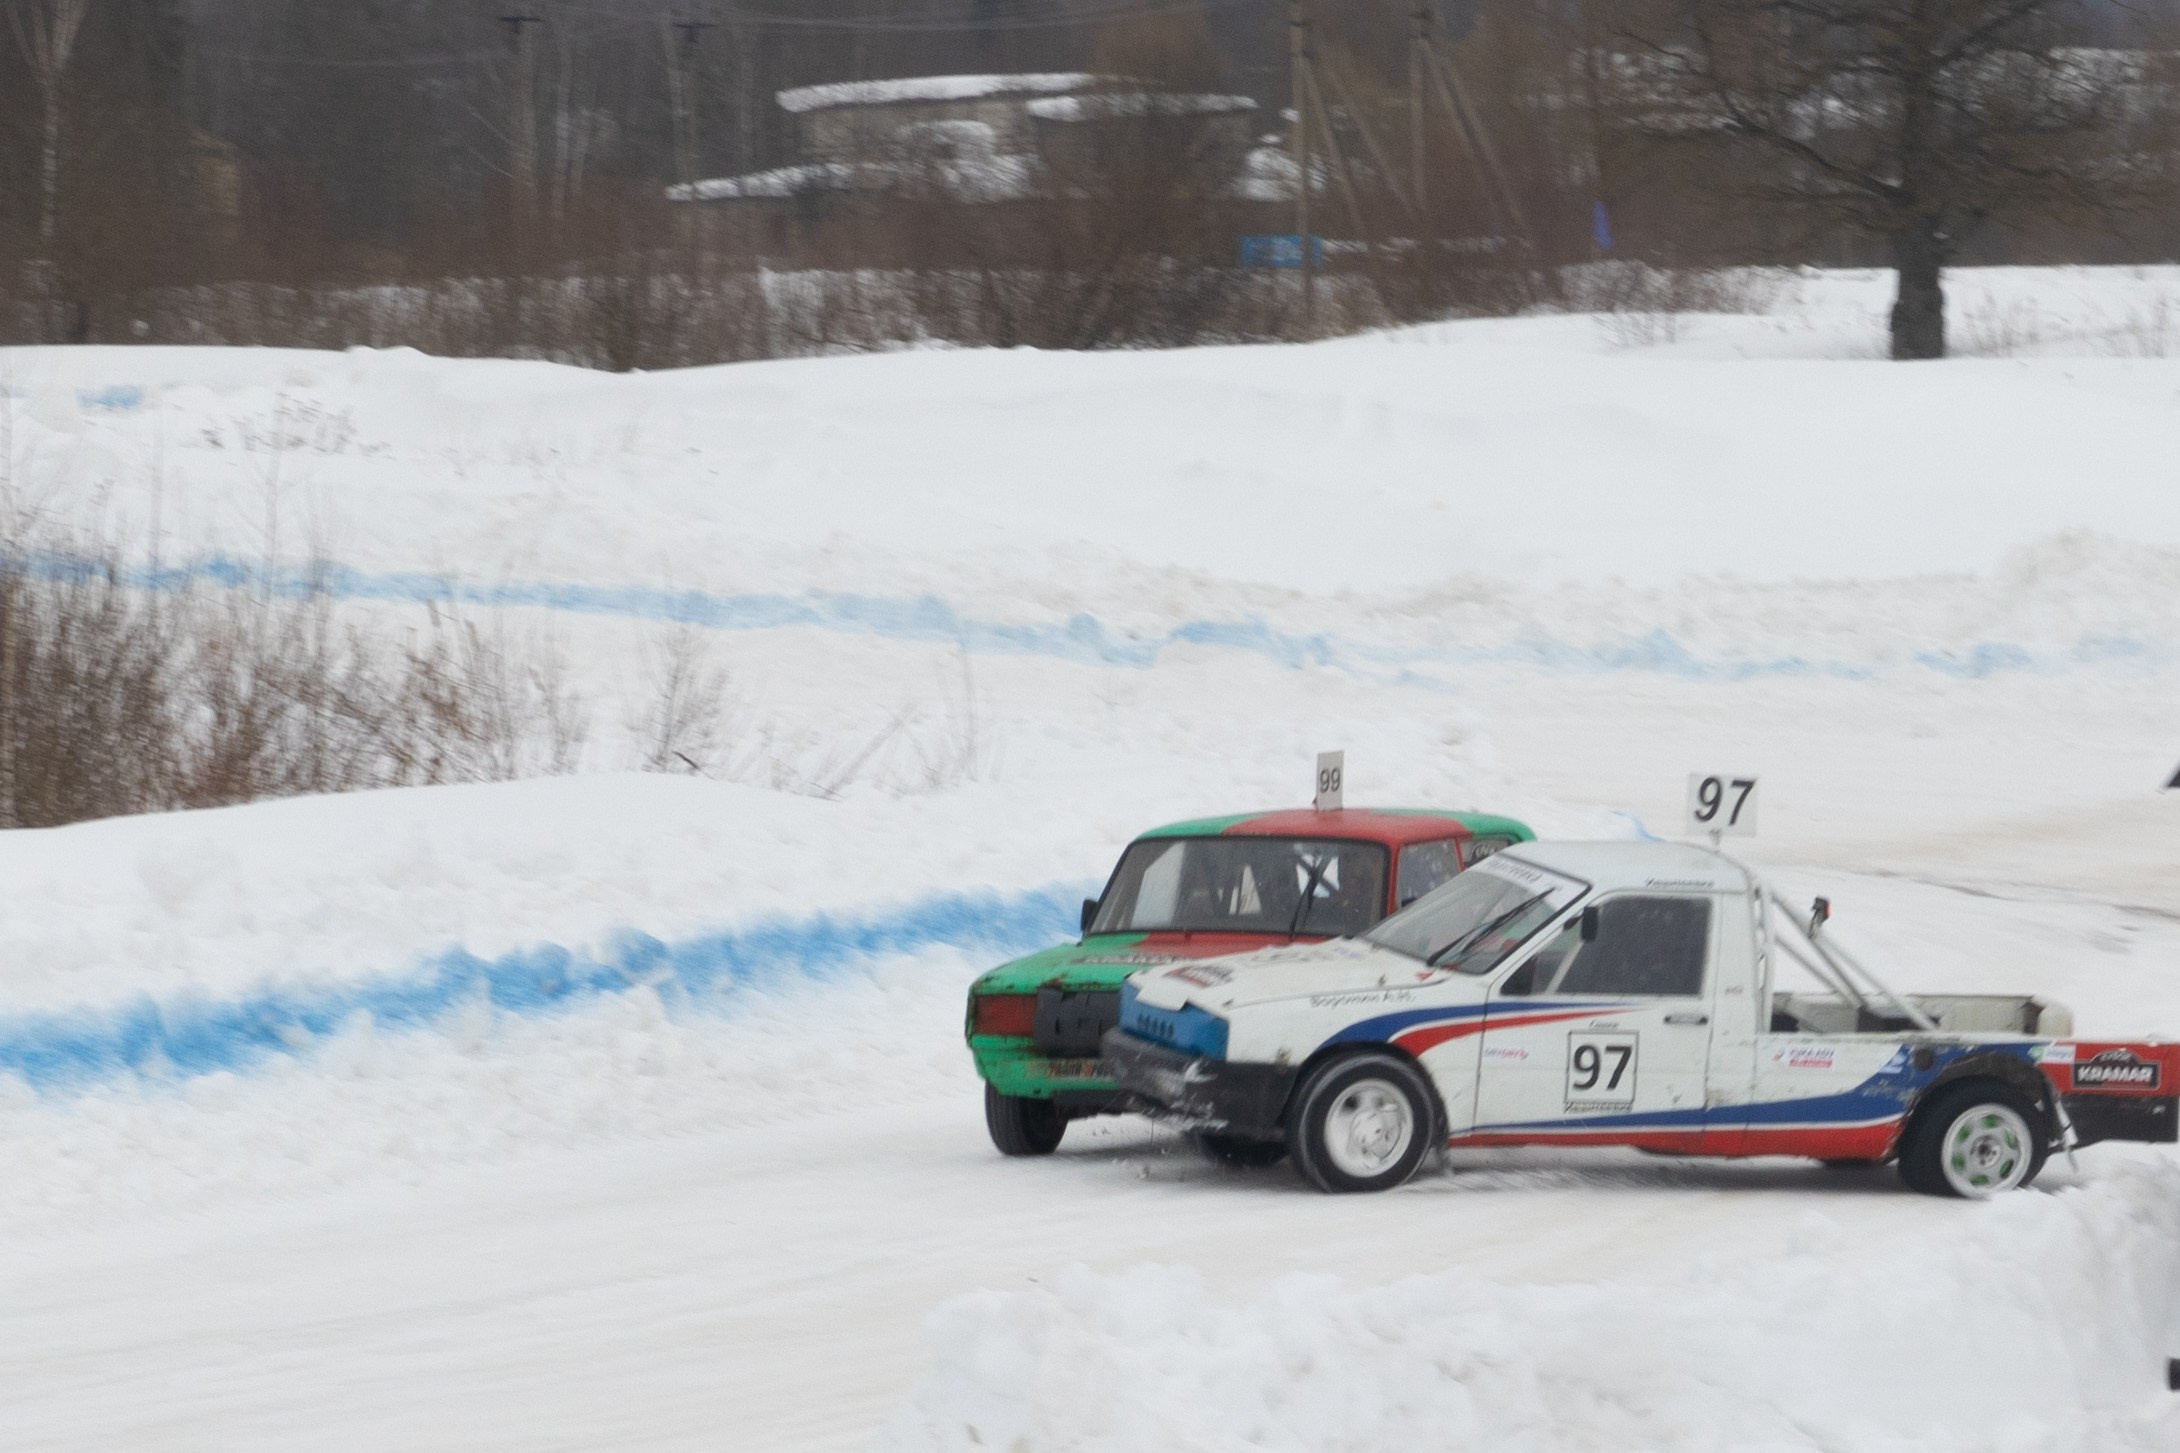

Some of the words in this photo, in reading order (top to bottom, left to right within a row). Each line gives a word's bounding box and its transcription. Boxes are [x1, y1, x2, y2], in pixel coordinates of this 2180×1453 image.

[1319, 767, 1341, 794] 99
[1693, 775, 1756, 827] 97
[1572, 1044, 1633, 1091] 97
[2077, 1065, 2153, 1082] KRAMAR
